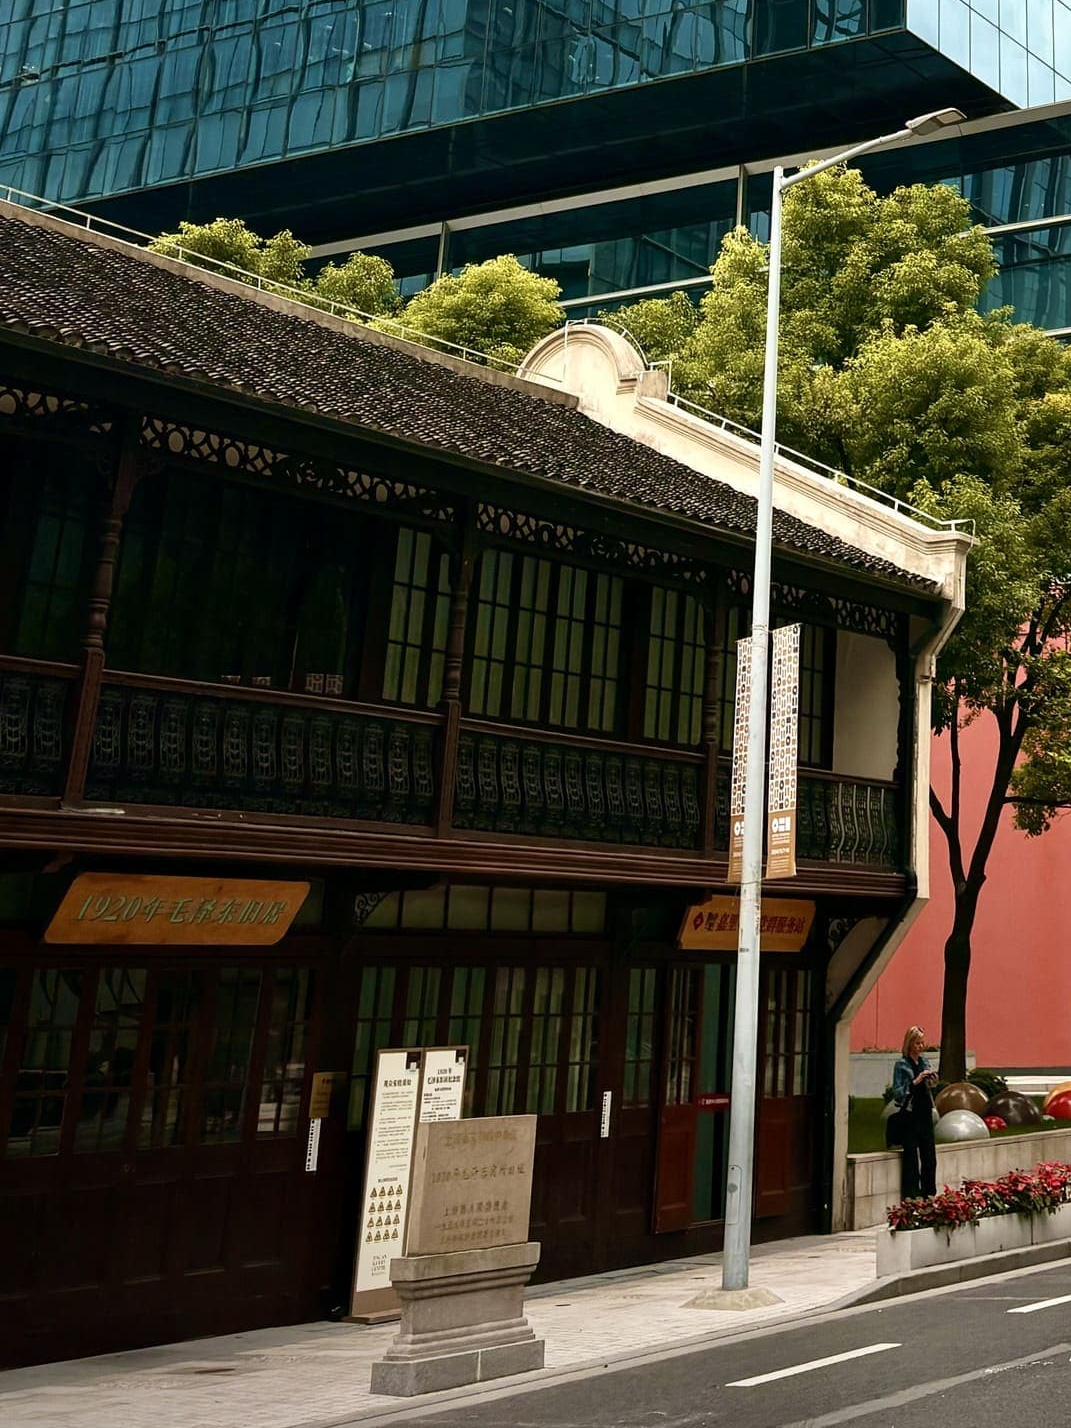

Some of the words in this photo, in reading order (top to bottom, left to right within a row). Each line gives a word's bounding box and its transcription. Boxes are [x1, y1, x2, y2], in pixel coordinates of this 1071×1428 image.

[76, 894, 288, 925] 1920年毛泽东旧居
